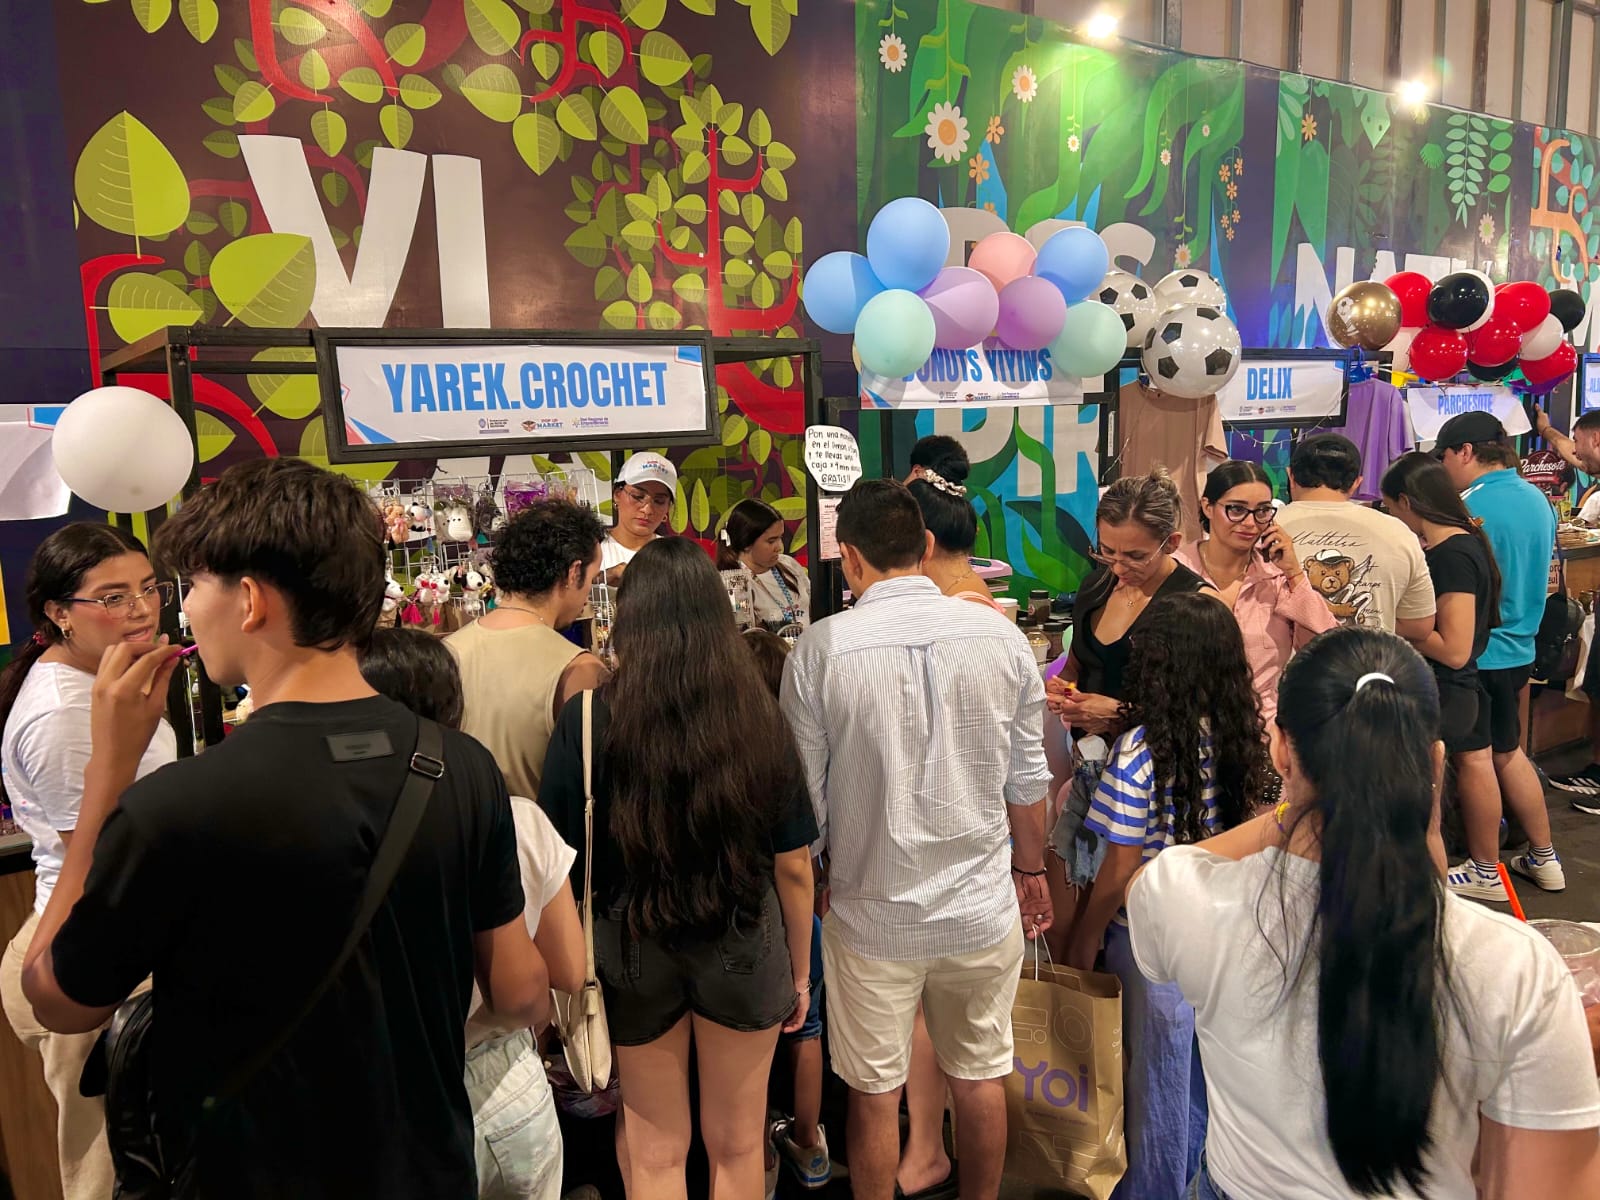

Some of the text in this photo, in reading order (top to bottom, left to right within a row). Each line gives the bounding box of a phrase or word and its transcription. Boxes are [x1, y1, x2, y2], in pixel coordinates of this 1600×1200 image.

[903, 348, 1052, 382] ONUTS YIYINS
[381, 362, 668, 413] YAREK.CROCHET
[1246, 367, 1293, 401] DELIX
[1438, 393, 1494, 415] PARCHESOTE
[808, 428, 823, 439] Pon
[827, 431, 839, 439] una
[812, 441, 820, 449] en
[824, 440, 829, 448] el
[825, 450, 842, 460] llevas
[812, 461, 827, 472] caja
